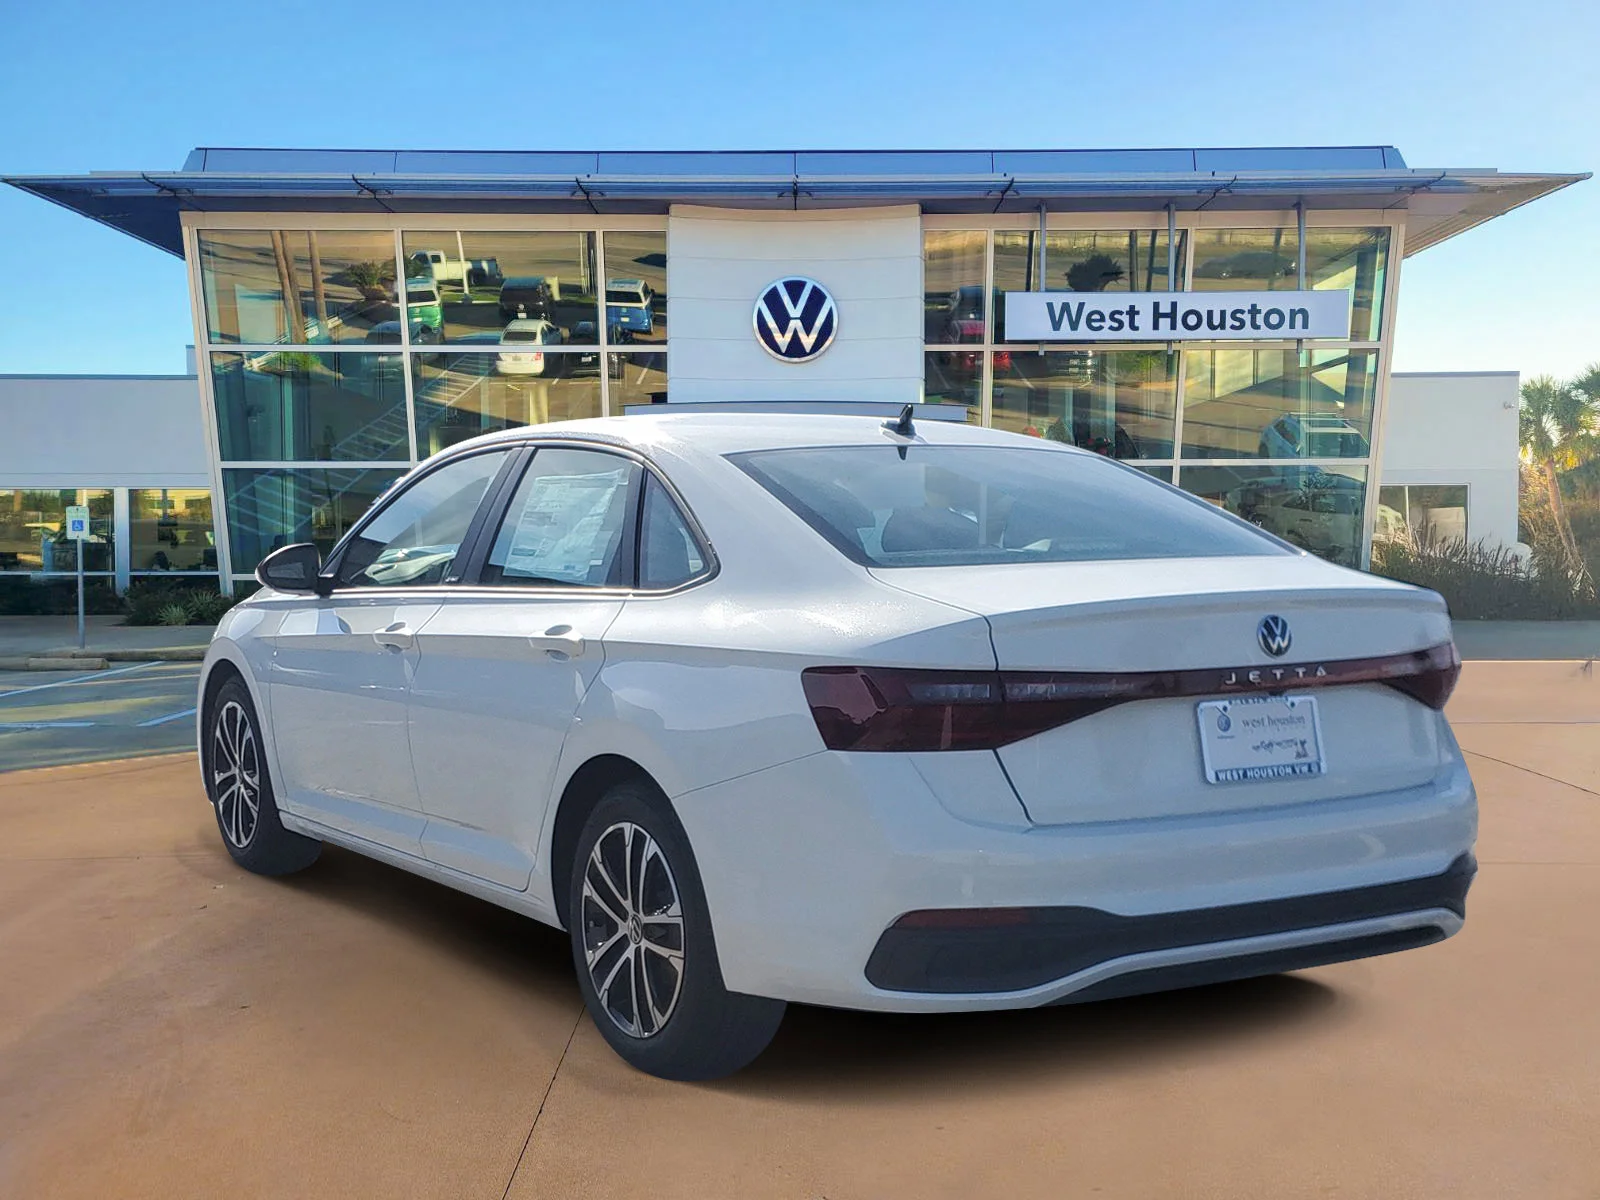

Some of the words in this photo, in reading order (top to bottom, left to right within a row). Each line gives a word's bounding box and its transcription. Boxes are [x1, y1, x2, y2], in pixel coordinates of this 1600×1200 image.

[753, 275, 838, 363] VW
[1046, 301, 1140, 332] West
[1152, 301, 1309, 331] Houston
[1257, 615, 1293, 657] VW
[1225, 666, 1327, 685] JETTA
[1217, 769, 1244, 781] WEST
[1246, 765, 1292, 779] HOUSTON
